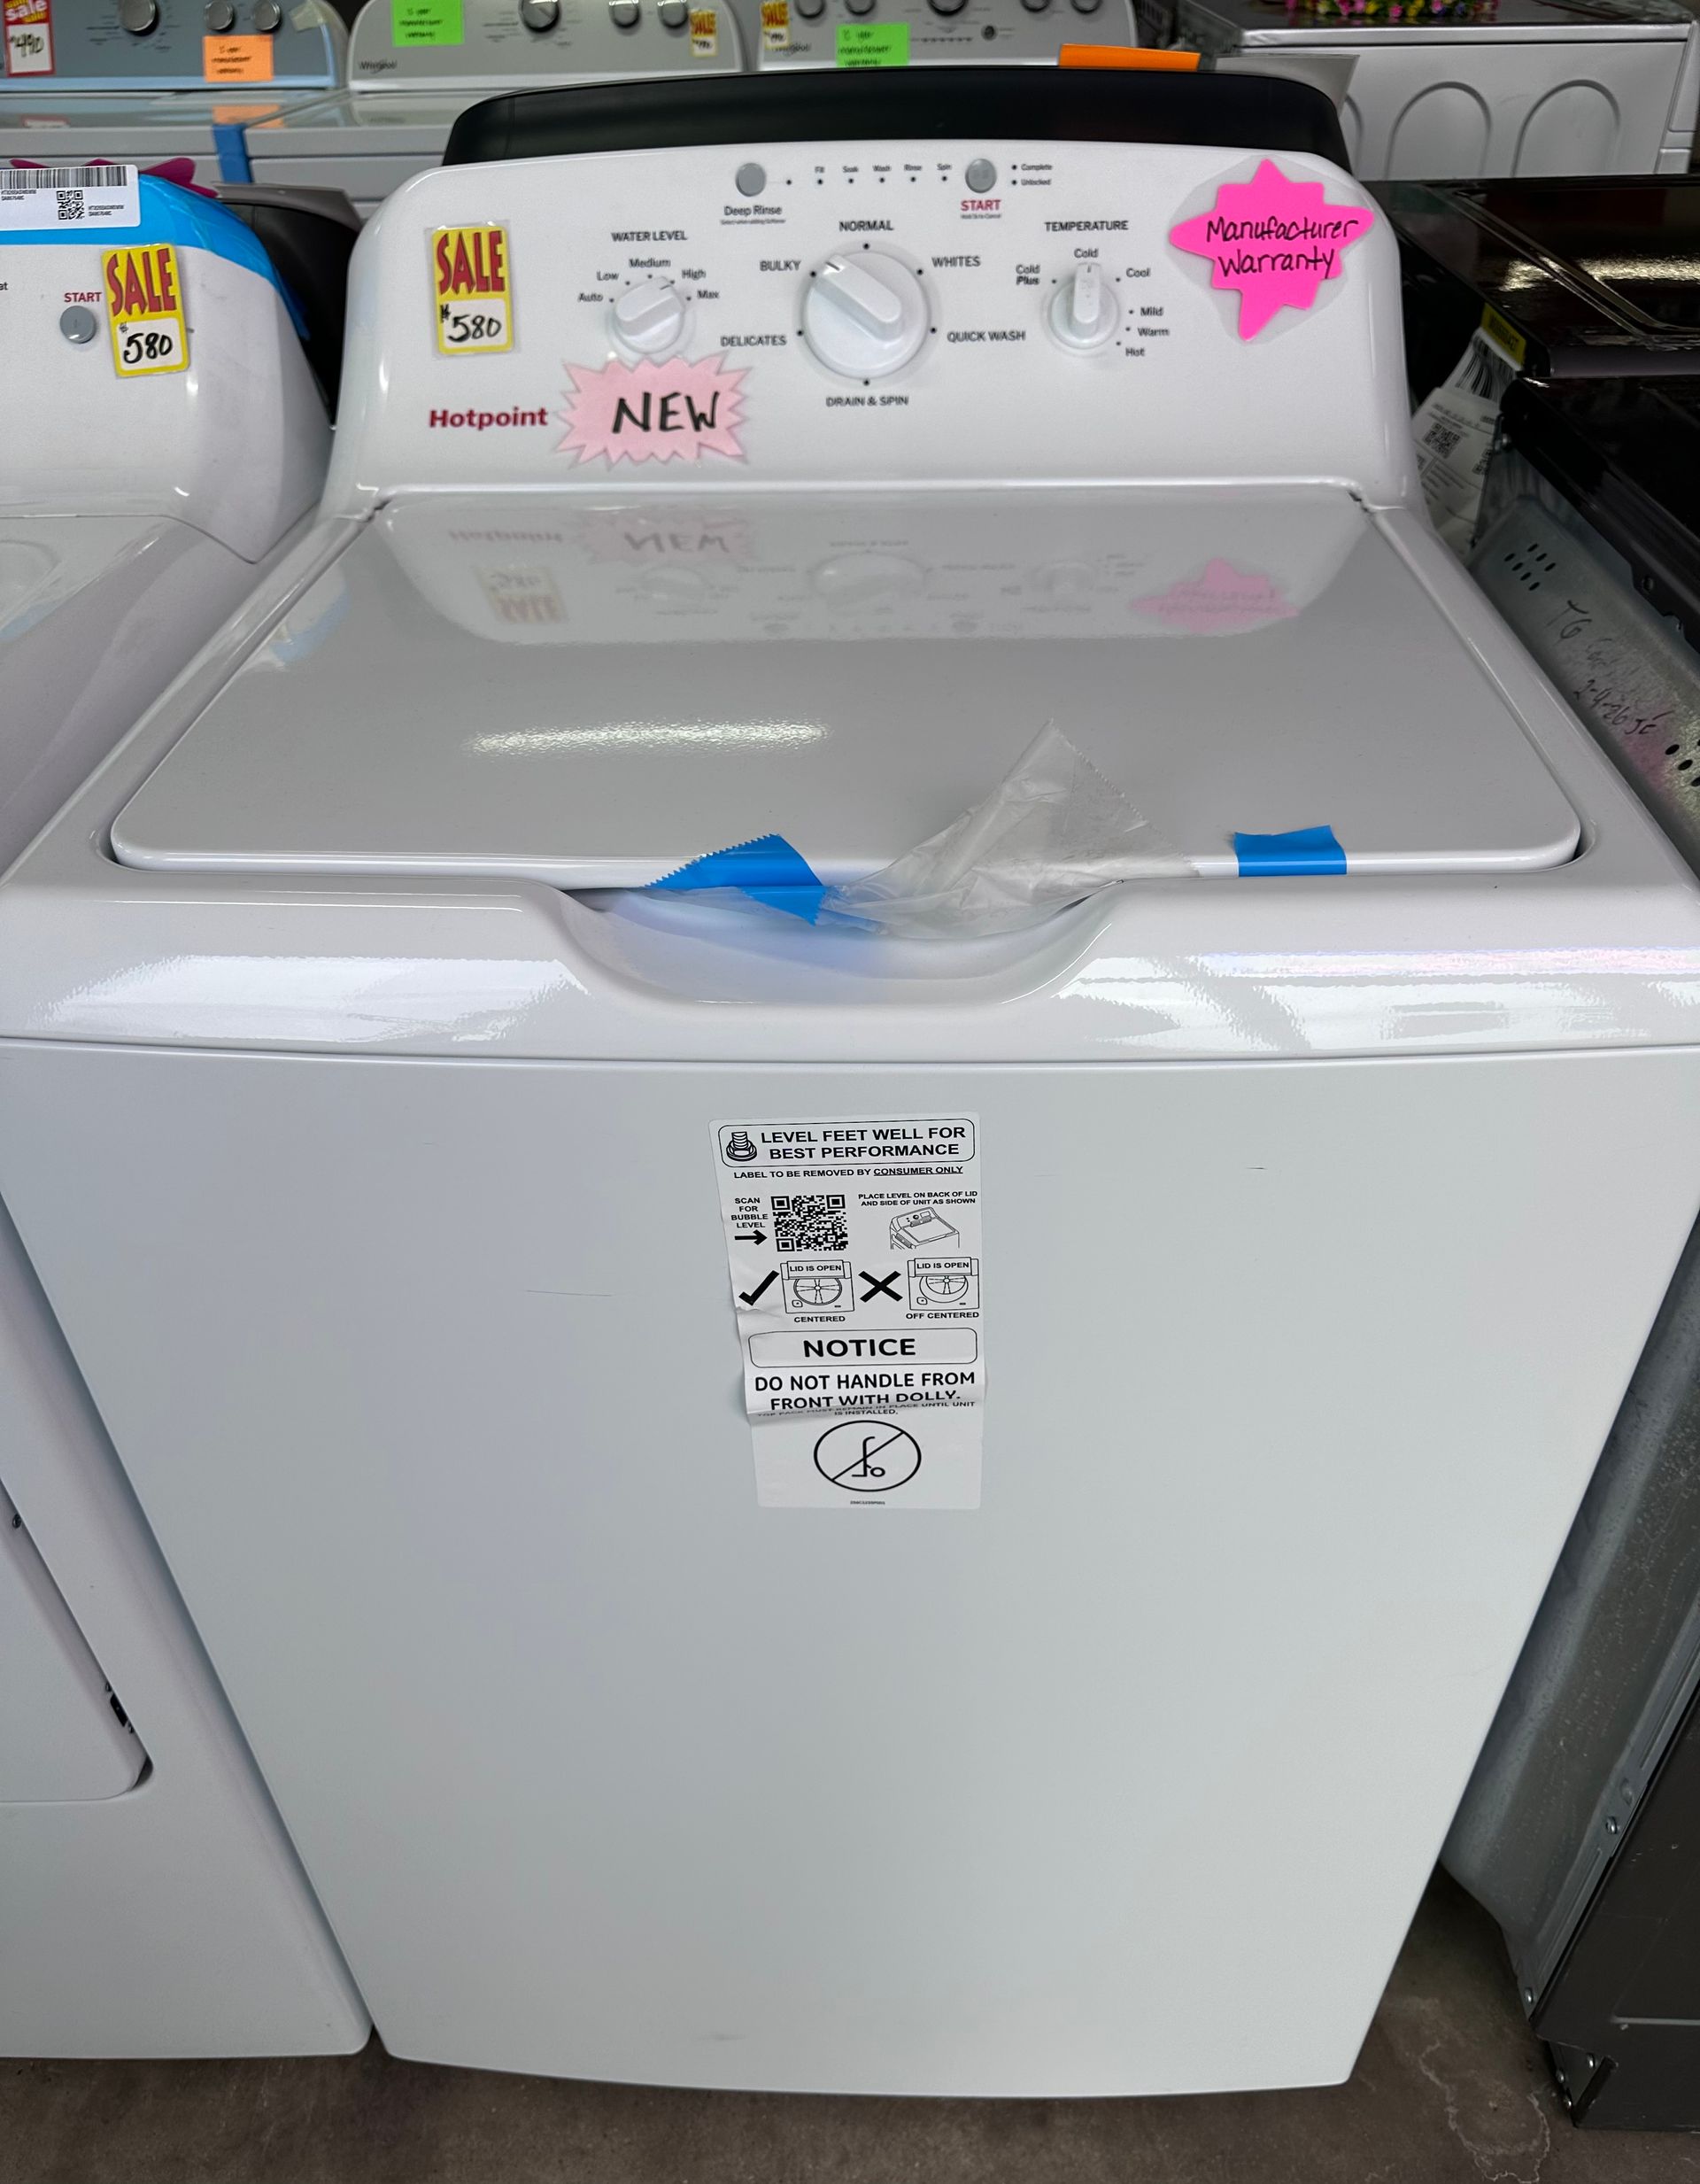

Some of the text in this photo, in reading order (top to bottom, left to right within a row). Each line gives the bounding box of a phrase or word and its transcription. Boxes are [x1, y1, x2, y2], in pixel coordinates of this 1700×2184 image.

[961, 199, 1001, 211] START
[723, 205, 782, 217] Deep Rinse
[839, 221, 893, 231] NORMAL
[1045, 221, 1128, 231] TEMPERATURE
[1207, 216, 1358, 243] Manufacturer
[612, 230, 687, 241] WATER LEVEL
[1074, 248, 1098, 258] Cold
[437, 230, 505, 295] SALE
[630, 259, 670, 267] Medium
[761, 260, 800, 271] BULKY
[931, 256, 980, 267] WHITES
[682, 269, 706, 280] High
[1016, 265, 1040, 275] Cold
[1126, 267, 1150, 277] Cool
[106, 247, 177, 317] SALE
[597, 272, 619, 281] Low
[1016, 275, 1039, 285] Plus
[65, 292, 102, 302] START
[1140, 307, 1163, 316] Mild
[947, 331, 1025, 343] QUICK WASH
[1138, 328, 1169, 337] Warm
[721, 336, 786, 346] DELICATES
[826, 396, 908, 407] DRAIN & SPIN
[612, 391, 720, 434] NEW
[429, 407, 548, 430] Hotpoint
[761, 1127, 966, 1142] LEVEL FEET WELL FOR
[769, 1143, 959, 1159] BEST PERFORMANCE
[935, 1166, 963, 1174] ONLY
[804, 1338, 916, 1357] NOTICE
[755, 1372, 974, 1391] DO NOT HANDLE FROM
[771, 1390, 961, 1410] FRONT WITH DOLLY.
